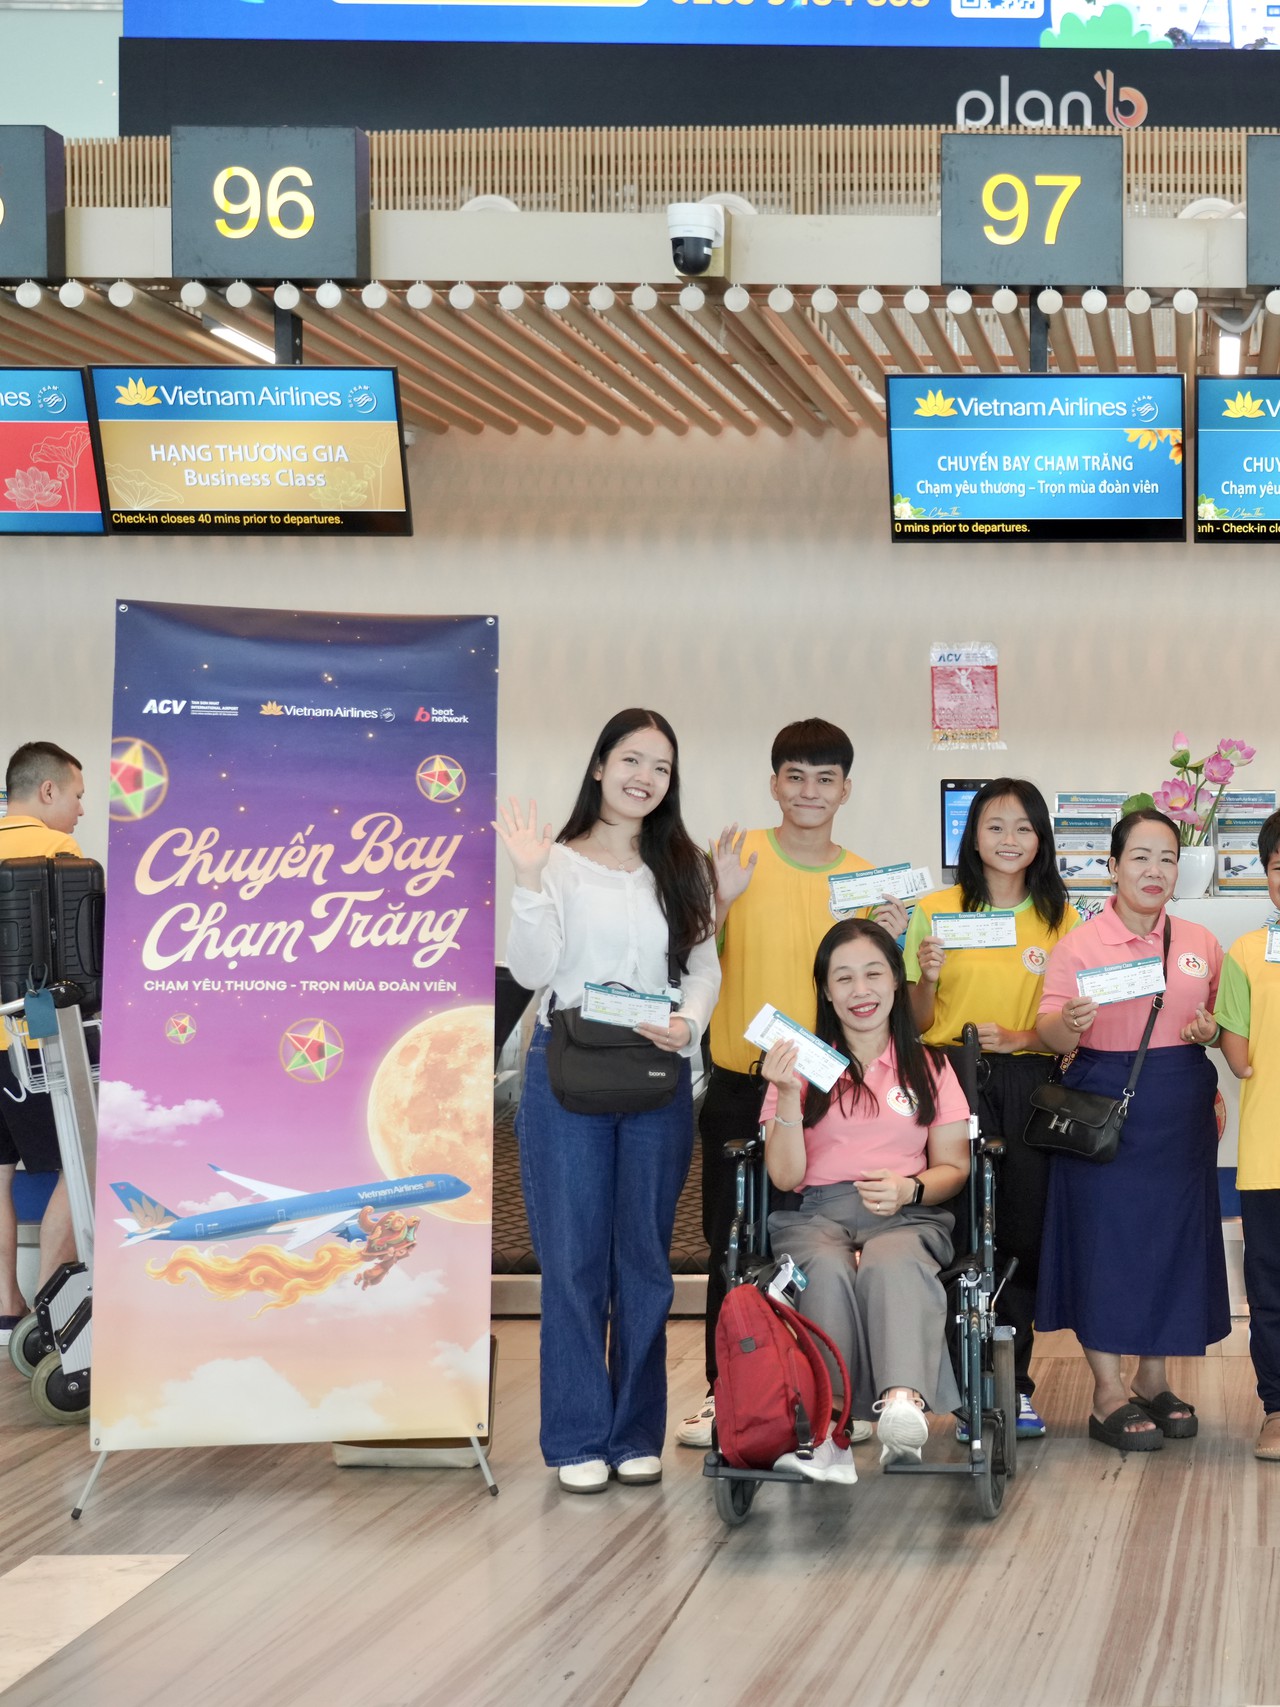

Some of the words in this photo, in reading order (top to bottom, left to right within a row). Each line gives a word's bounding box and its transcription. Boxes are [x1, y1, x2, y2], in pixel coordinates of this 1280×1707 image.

[212, 165, 316, 240] 96
[981, 173, 1082, 246] 97
[150, 443, 213, 468] HẠNG
[215, 443, 309, 464] THƯƠNG
[312, 444, 349, 463] GIA
[937, 450, 999, 472] CHUYẾN
[1002, 456, 1031, 471] BAY
[1034, 455, 1080, 475] CHẠM
[1081, 453, 1134, 471] TRĂNG
[184, 468, 271, 487] Business
[274, 468, 327, 487] Class
[916, 480, 953, 498] Chạm
[955, 480, 978, 498] yêu
[980, 480, 1027, 498] thương
[1037, 481, 1067, 498] Trọn
[1068, 481, 1096, 494] mùa
[1098, 480, 1131, 494] đoàn
[1132, 480, 1160, 495] viên
[1220, 481, 1257, 498] Chạm
[112, 513, 158, 526] Check-in
[160, 514, 195, 526] closes
[198, 514, 212, 526] 40
[214, 514, 240, 526] mins
[243, 514, 267, 529] prior
[269, 515, 282, 526] to
[283, 514, 344, 529] departures.
[904, 522, 930, 533] mins
[932, 522, 956, 535] prior
[958, 523, 970, 533] to
[971, 522, 1031, 535] departures.
[1222, 523, 1267, 534] Check-in
[938, 653, 961, 663] ACV
[142, 699, 187, 714] ACV
[431, 707, 454, 716] beat
[431, 714, 469, 723] network
[135, 824, 335, 900] Chuyến
[341, 812, 463, 897] Bay
[142, 902, 305, 971] Chạm
[309, 888, 469, 968] Trăng
[144, 979, 189, 993] CHẠM
[192, 978, 222, 991] YÊU
[225, 978, 287, 991] THƯƠNG
[300, 980, 340, 993] TRỌN
[343, 978, 375, 992] MÙA
[379, 978, 420, 992] ĐOÀN
[423, 979, 457, 992] VIÊN
